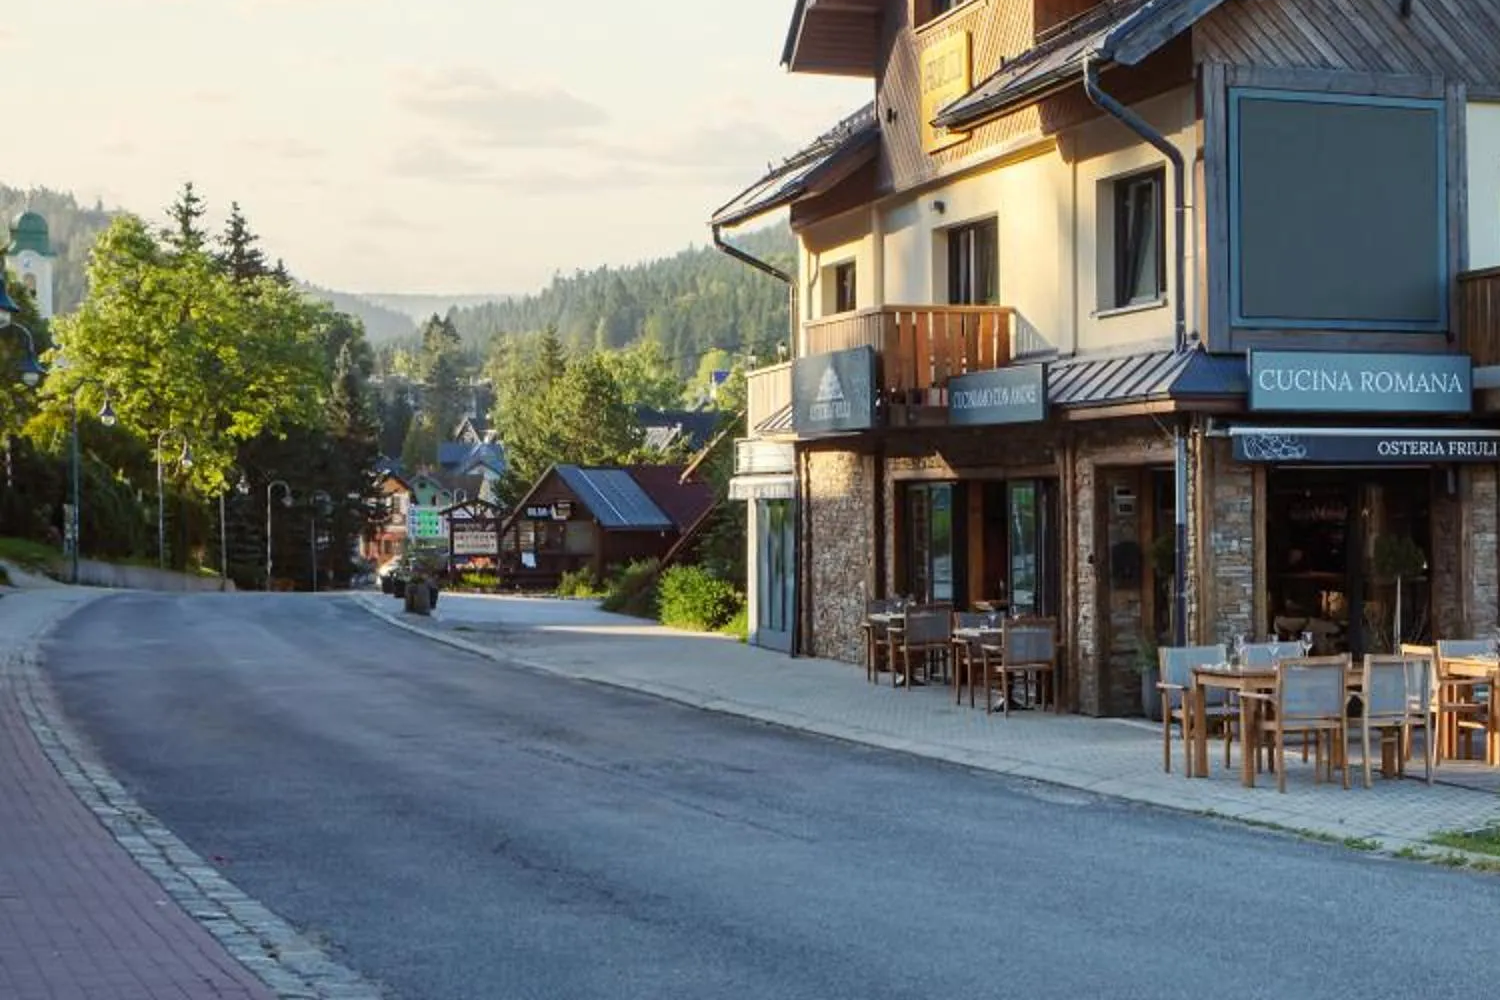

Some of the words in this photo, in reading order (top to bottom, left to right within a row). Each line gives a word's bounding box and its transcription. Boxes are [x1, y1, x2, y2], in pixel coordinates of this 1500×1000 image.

[1258, 368, 1353, 392] CUCINA
[1360, 370, 1463, 394] ROMANA
[1377, 441, 1445, 456] OSTERIA
[1448, 441, 1498, 457] FRIULI
